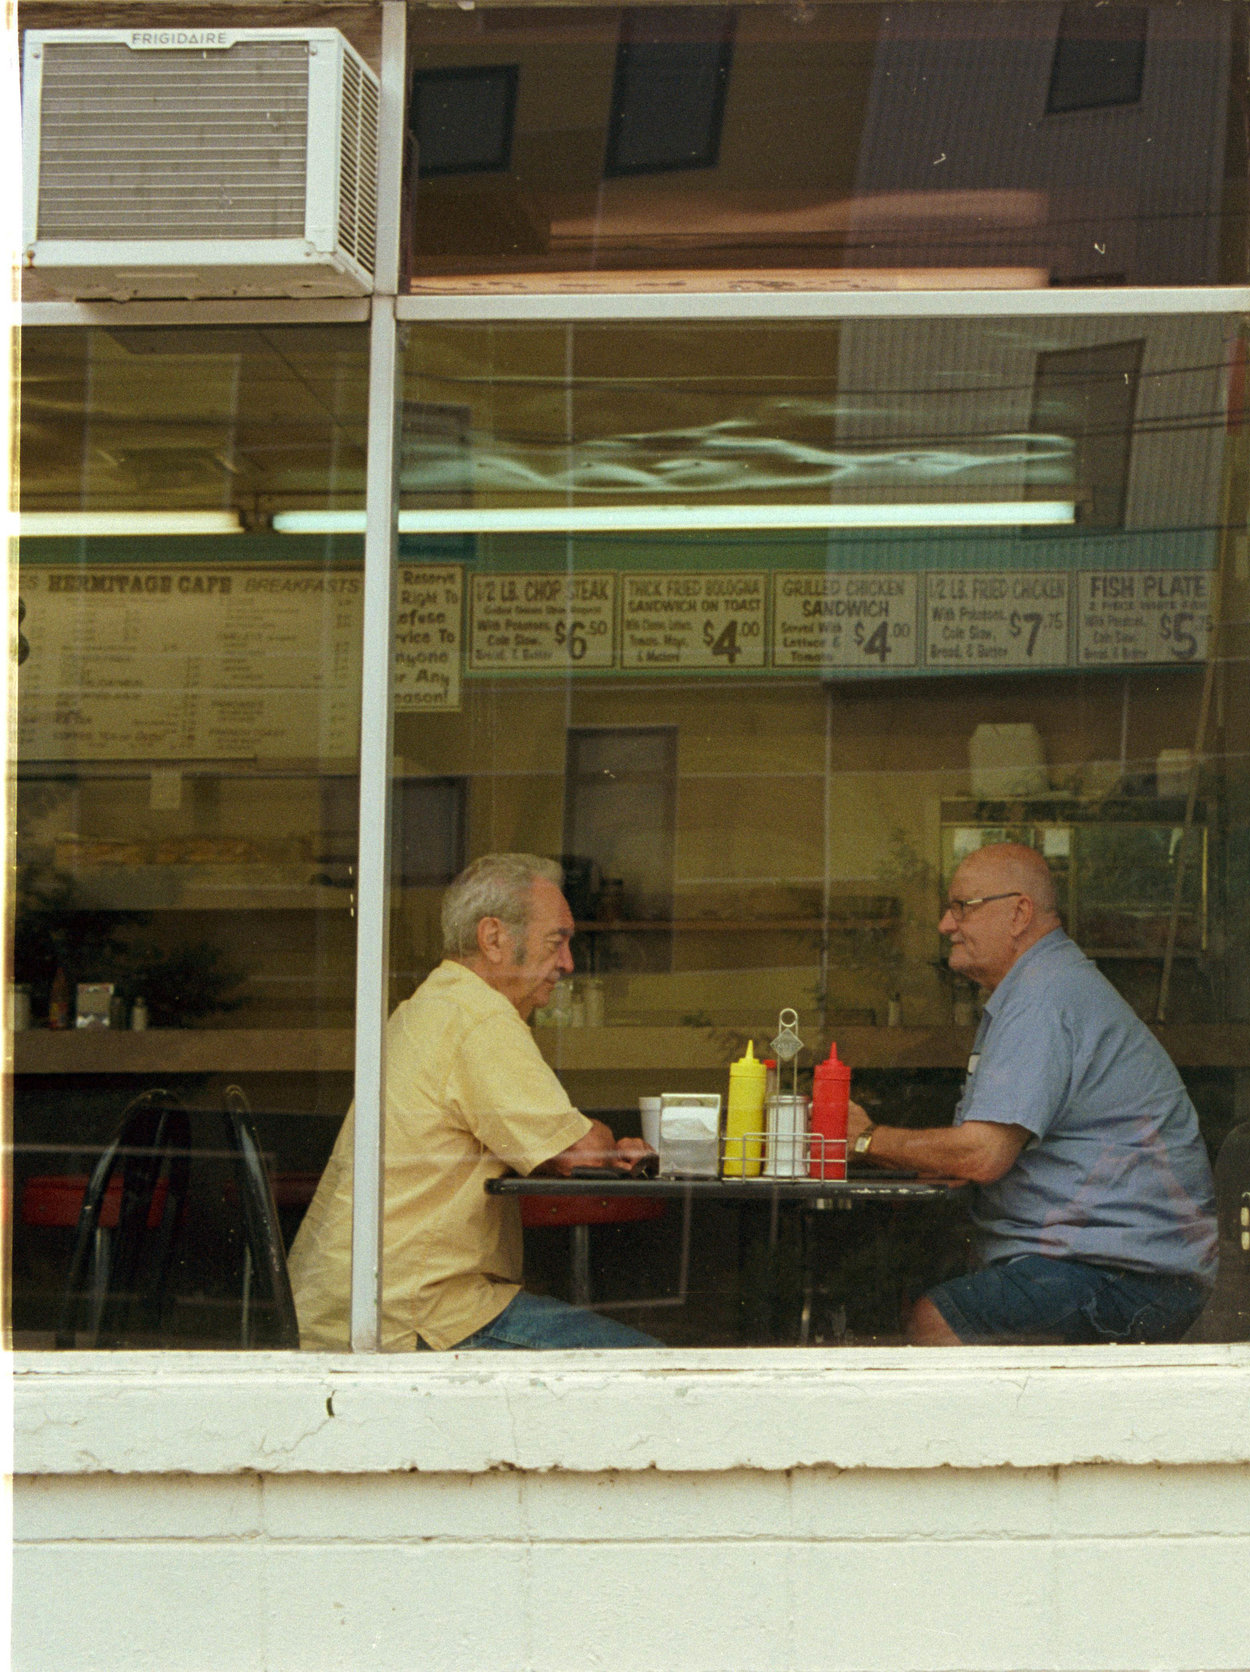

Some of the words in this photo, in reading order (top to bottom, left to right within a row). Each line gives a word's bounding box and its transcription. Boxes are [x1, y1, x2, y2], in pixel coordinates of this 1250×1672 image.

[132, 32, 227, 44] FRIGIDAIRE
[48, 574, 172, 593] HERMITAGE
[177, 574, 232, 593] CAFE
[244, 577, 361, 593] BREAKFASTS
[403, 570, 455, 584] Reserve
[525, 581, 561, 600] CHOP
[667, 579, 700, 596] FRIED
[705, 578, 760, 595] BOLOGNA
[783, 579, 841, 596] GRILLED
[846, 578, 905, 596] CHICKEN
[1090, 575, 1135, 598] FISH
[1144, 575, 1208, 597] PLATE
[401, 589, 438, 606] Right
[445, 588, 459, 604] To
[628, 600, 696, 612] SANDWICH
[702, 600, 718, 611] ON
[724, 599, 761, 611] TOAST
[802, 600, 890, 617] SANDWICH
[396, 609, 446, 626] efuse
[439, 629, 455, 643] To
[854, 621, 911, 662] $4.00
[416, 669, 449, 686] Any
